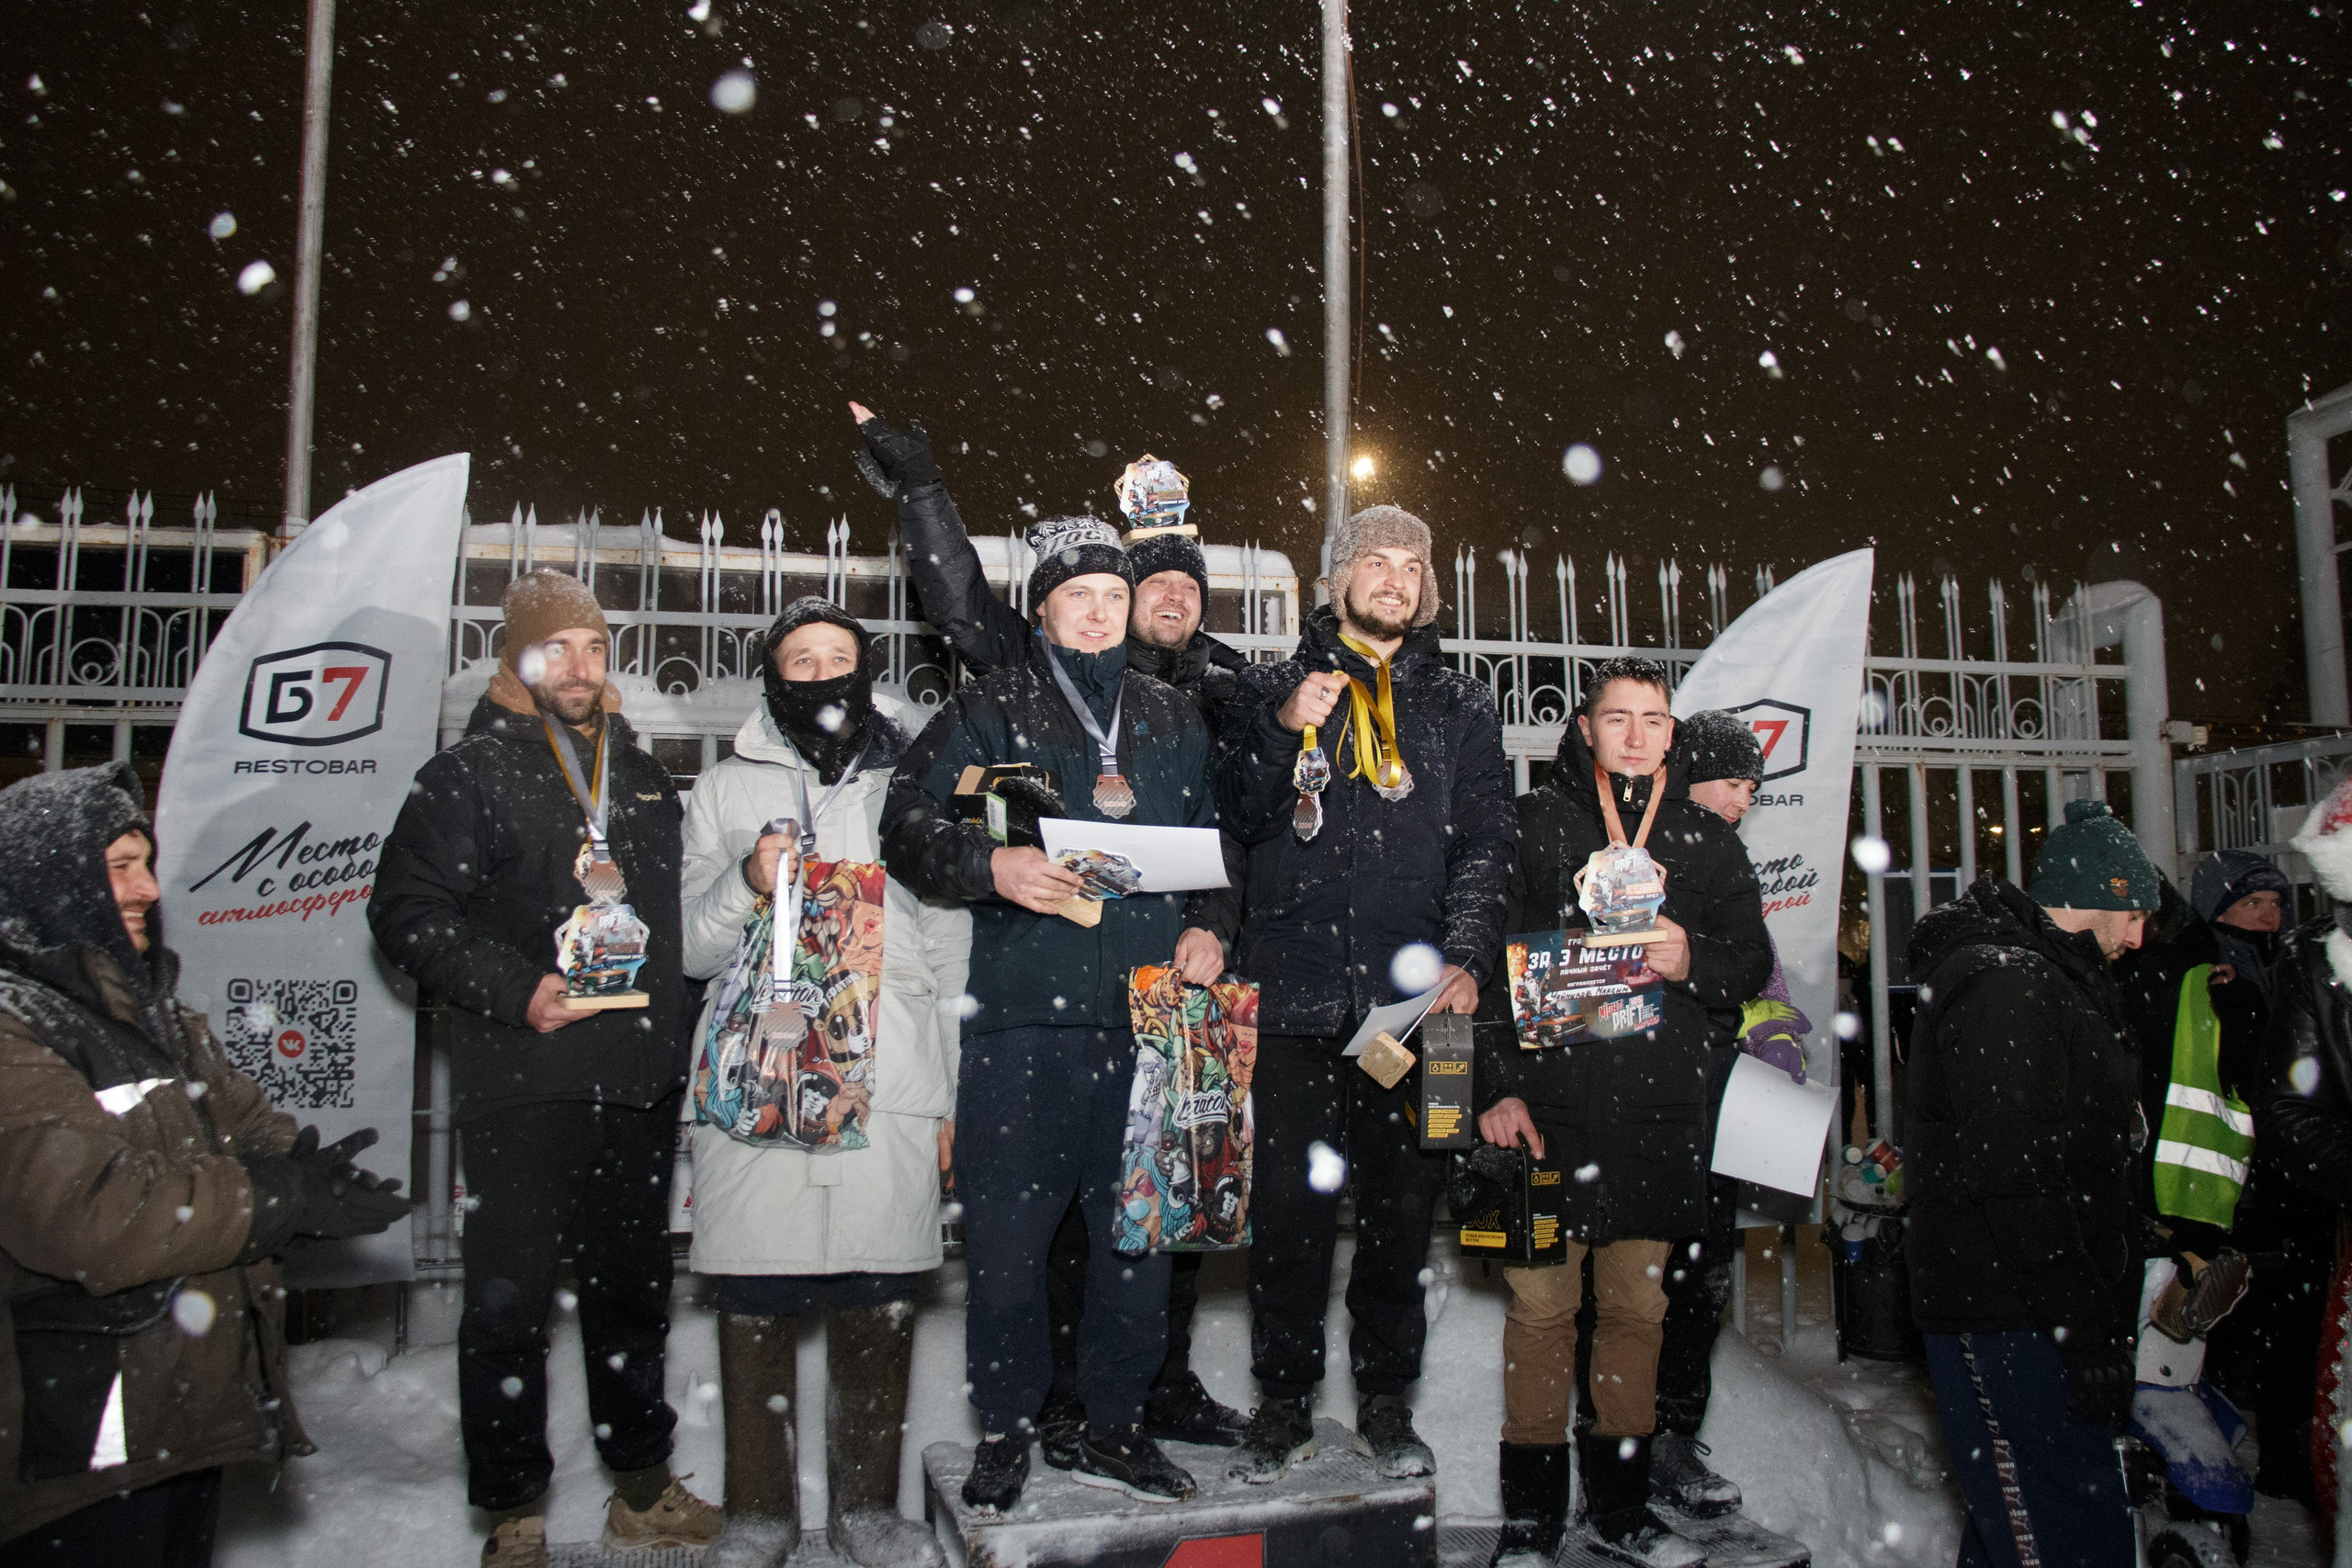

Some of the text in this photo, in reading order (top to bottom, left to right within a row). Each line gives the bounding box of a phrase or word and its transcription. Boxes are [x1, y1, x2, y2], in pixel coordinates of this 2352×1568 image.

[266, 666, 369, 724] Б7
[1751, 720, 1790, 761] 7
[233, 759, 378, 774] RESTOBAR
[1749, 794, 1804, 807] OBAR
[189, 820, 382, 893] Место
[1752, 853, 1805, 875] сто
[257, 852, 376, 897] с особо
[1759, 867, 1820, 897] обой
[198, 884, 374, 926] атмосферо
[1528, 944, 1644, 970] ЗА 3 МЕСТО
[1559, 966, 1588, 976] ЛИЧНЫЙ
[751, 975, 823, 1009] Leton
[1611, 1003, 1645, 1032] DRIFT
